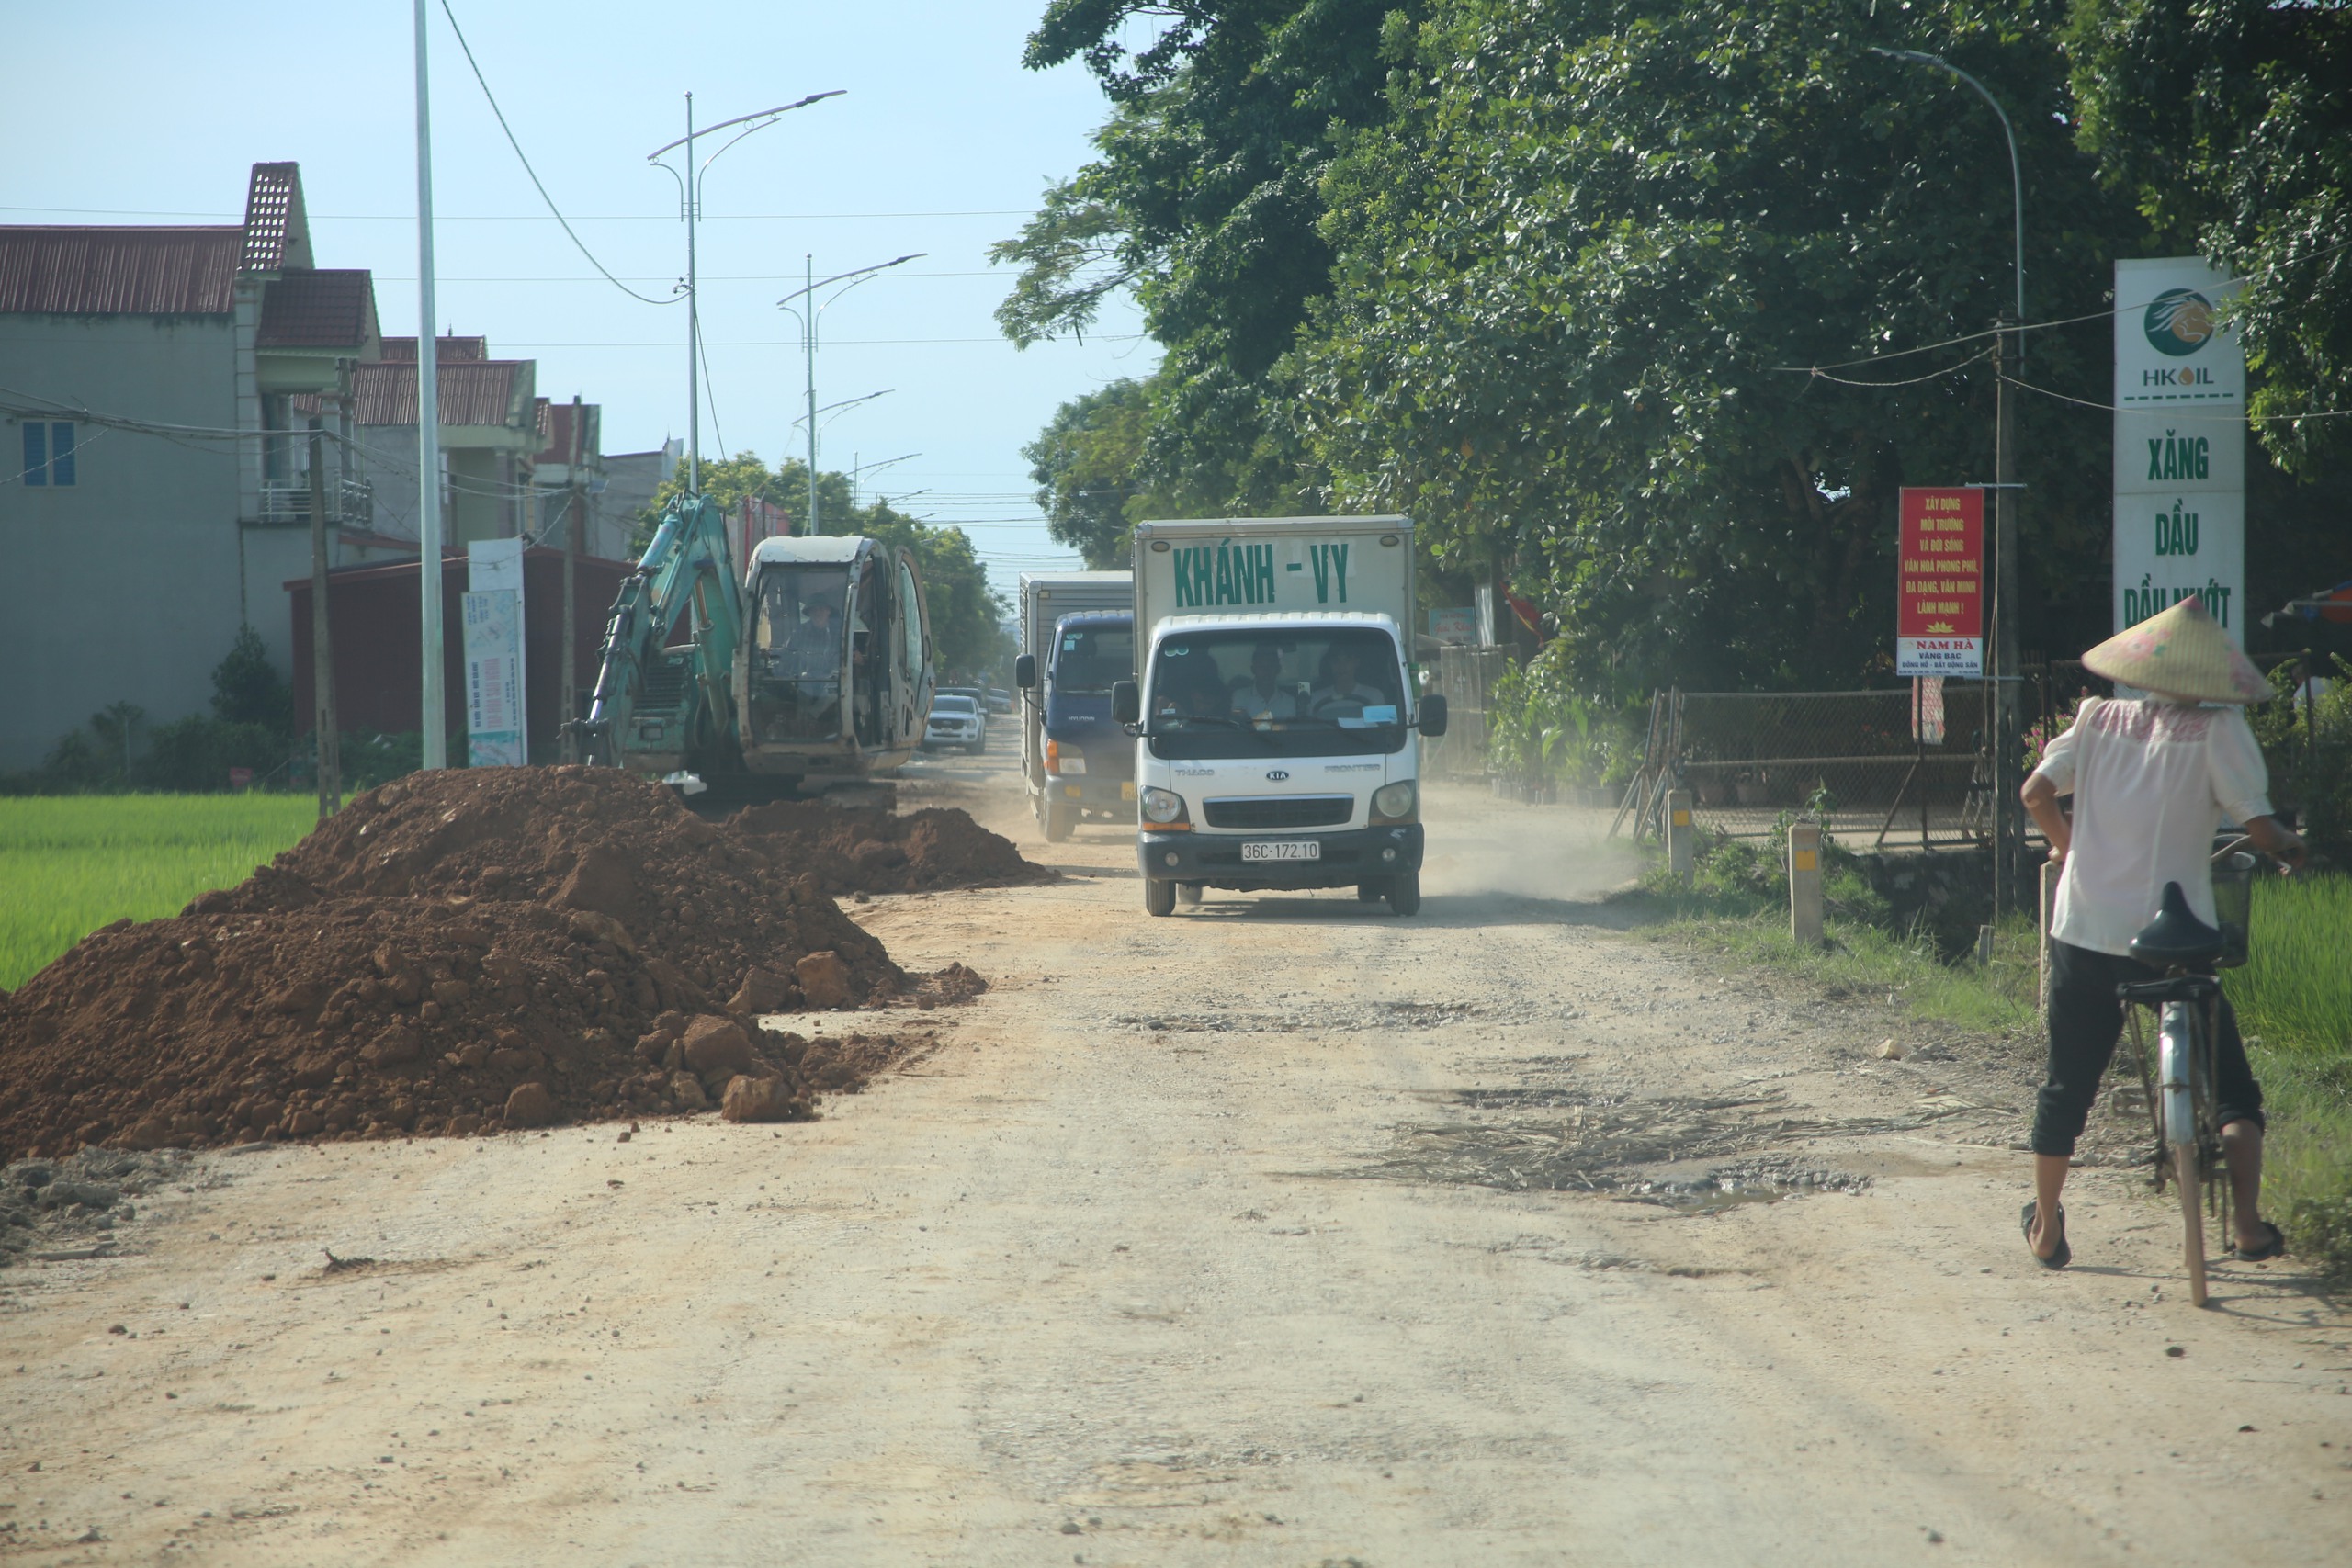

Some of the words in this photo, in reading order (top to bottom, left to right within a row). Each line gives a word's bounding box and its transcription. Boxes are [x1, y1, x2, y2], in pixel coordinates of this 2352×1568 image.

[2148, 429, 2209, 480] XĂNG
[2155, 499, 2199, 556] DẦU
[1173, 536, 1275, 608] KHÁNH
[1310, 543, 1349, 604] VY
[1936, 559, 1961, 572] PHONG
[1957, 581, 1976, 593] MINH
[2124, 573, 2166, 630] DẦU
[2173, 578, 2231, 628] ỚT
[1917, 640, 1949, 649] NAM
[1953, 638, 1974, 649] HÀ
[1944, 652, 1962, 660] BẠC
[1269, 772, 1286, 780] KIA
